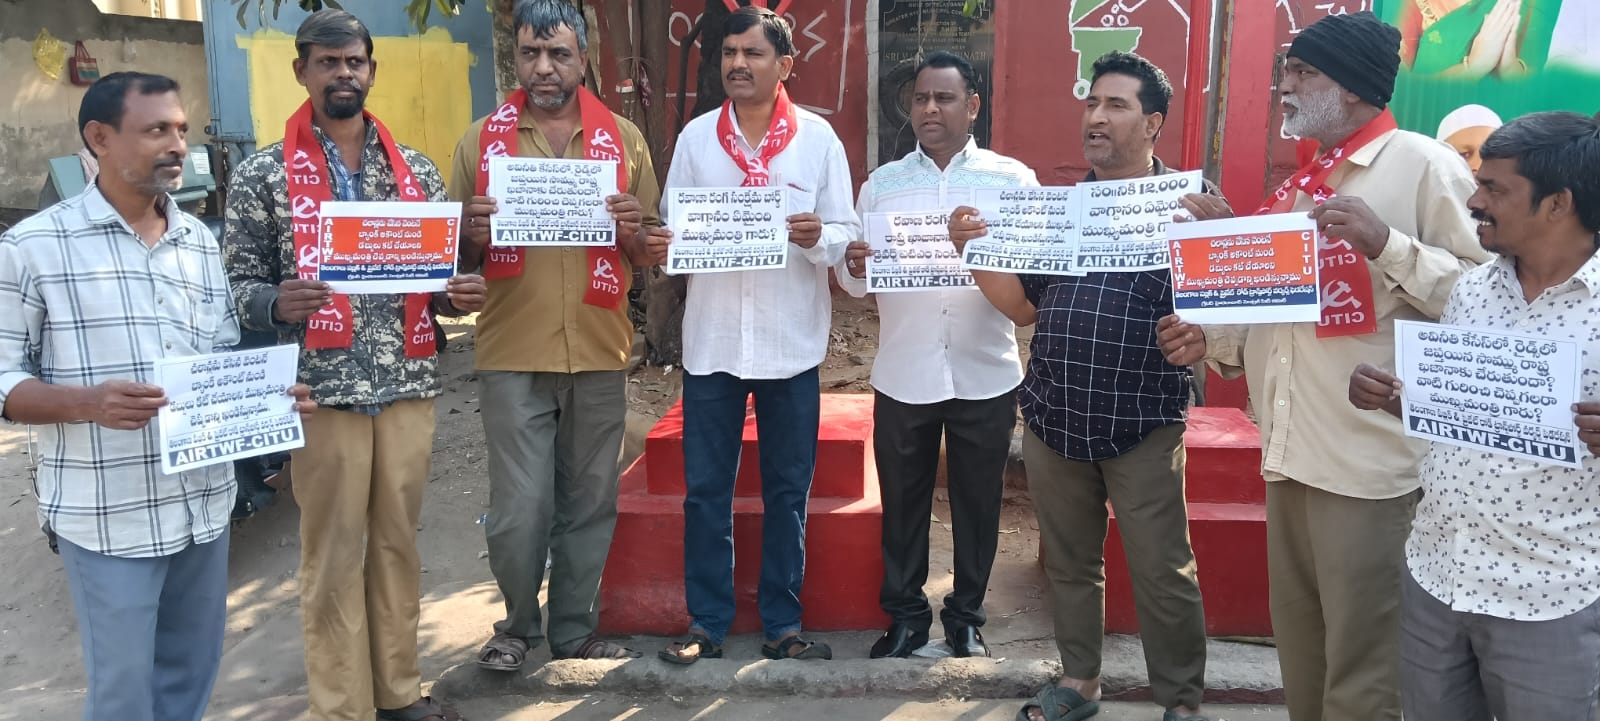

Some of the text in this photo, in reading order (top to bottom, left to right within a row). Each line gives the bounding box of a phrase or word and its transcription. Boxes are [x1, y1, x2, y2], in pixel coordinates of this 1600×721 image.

[501, 231, 607, 241] AIRTWF-CITU
[1081, 252, 1167, 267] AIRTWF-CI
[1301, 232, 1312, 275] CITU
[677, 256, 778, 268] AIRTWF-CITU
[876, 276, 975, 288] AIRTWF-CITU
[1502, 406, 1542, 423] గారు?
[176, 428, 294, 466] AIRTWF-CITU
[1416, 419, 1567, 460] AIRTWF-CITU
